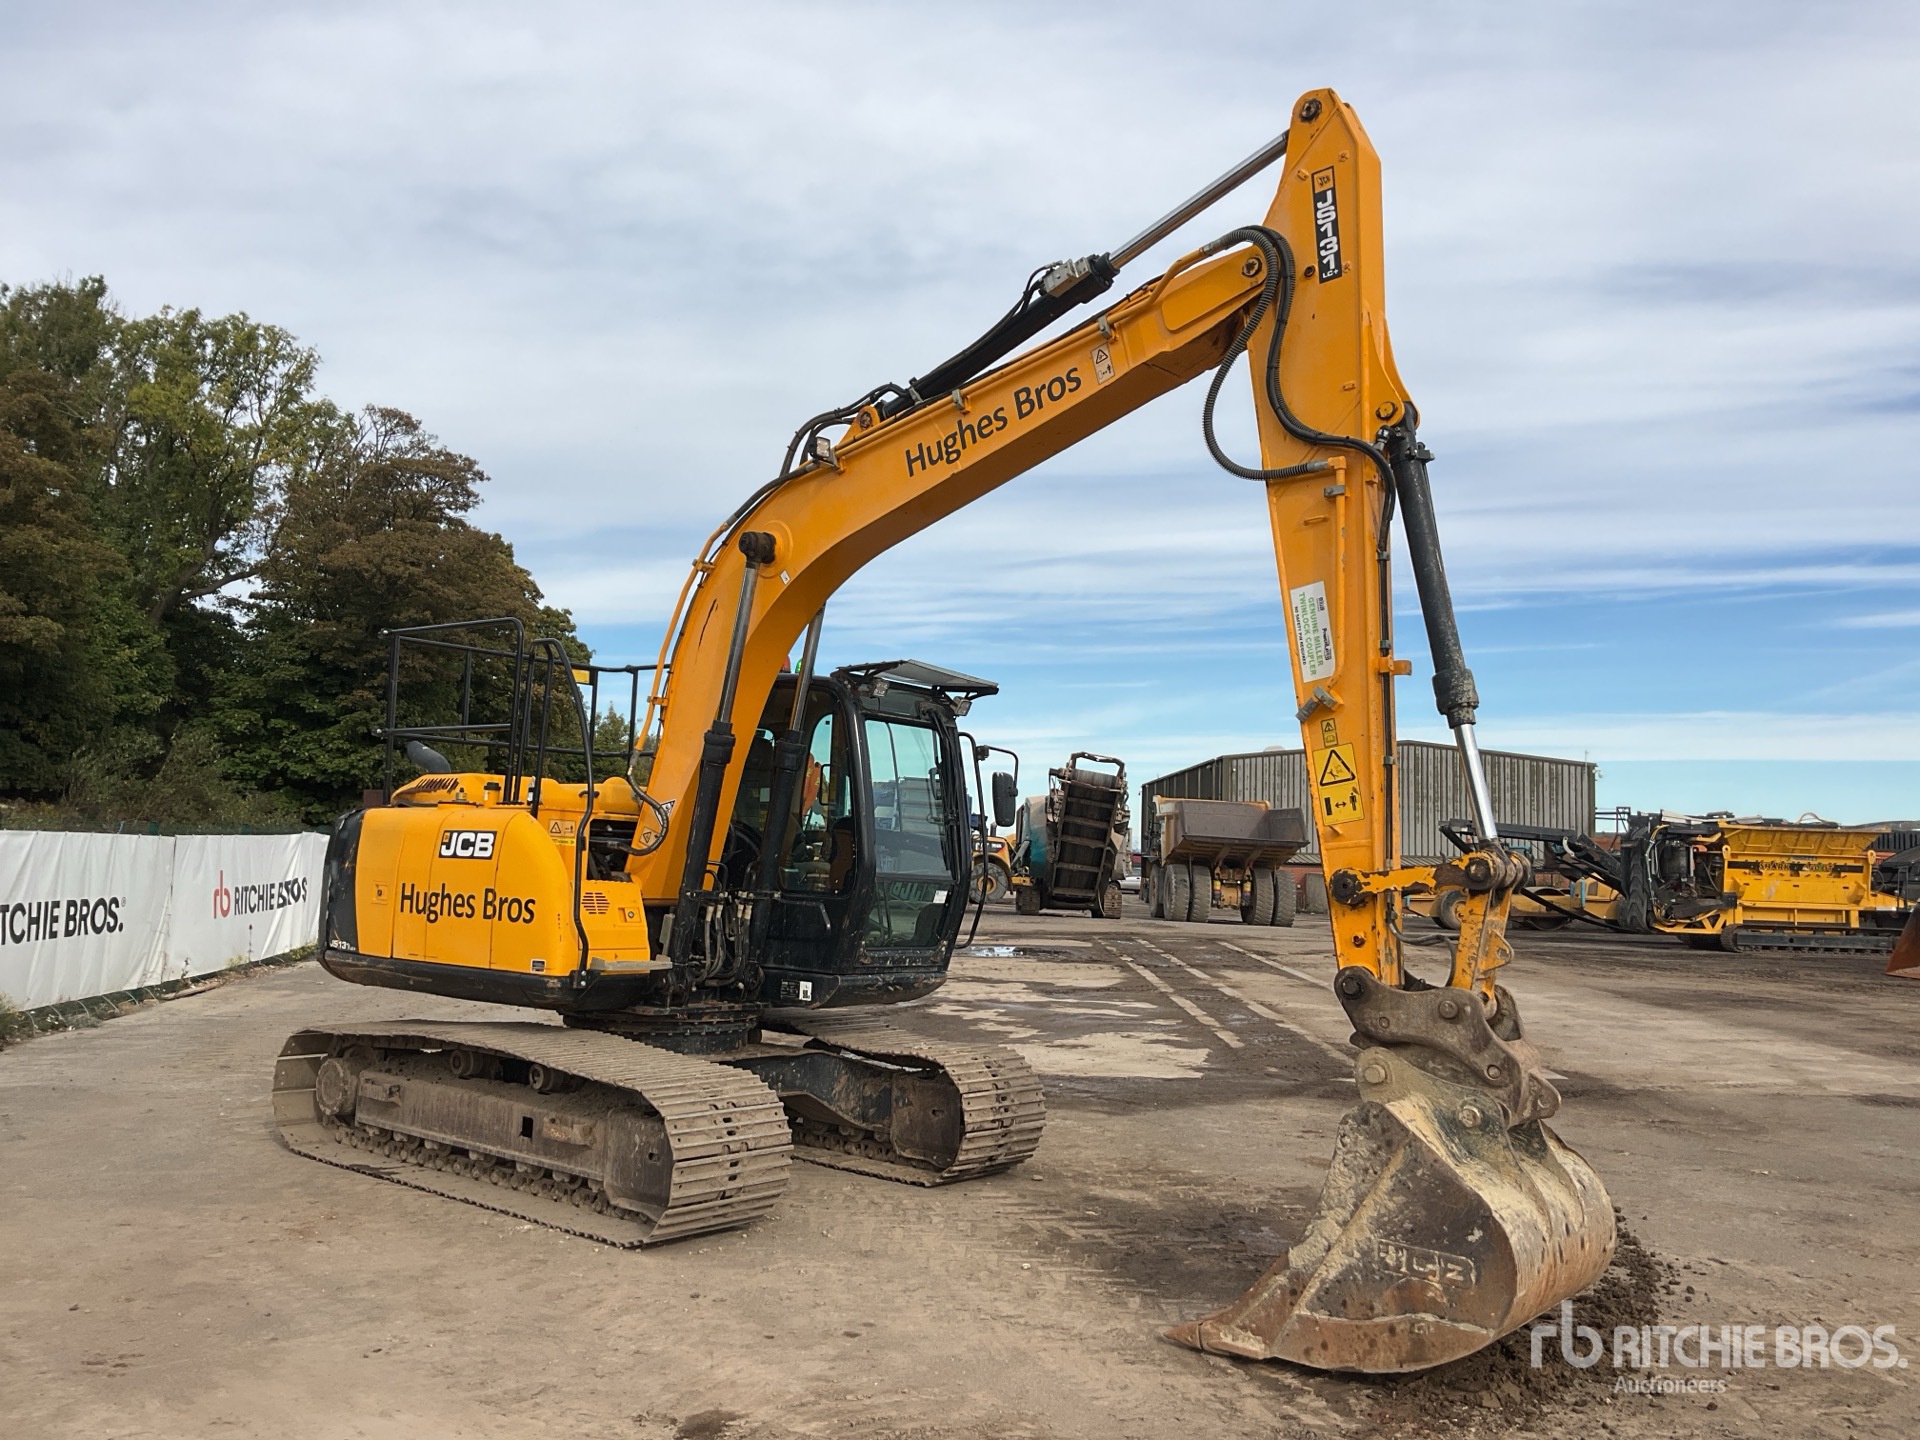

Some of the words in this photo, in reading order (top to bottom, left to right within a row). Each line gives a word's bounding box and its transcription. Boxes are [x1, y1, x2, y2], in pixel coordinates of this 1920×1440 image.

[1316, 189, 1339, 270] JS131
[905, 406, 1009, 477] Hughes
[1013, 367, 1082, 420] Bros
[1299, 593, 1310, 635] TWINLOCK
[1305, 637, 1317, 676] COUPLER
[1308, 597, 1319, 634] GENUINE
[1314, 635, 1324, 666] MILLER
[441, 832, 494, 857] JCB
[234, 883, 275, 915] RITCHIE
[400, 883, 476, 924] Hughes
[482, 887, 536, 925] Bros
